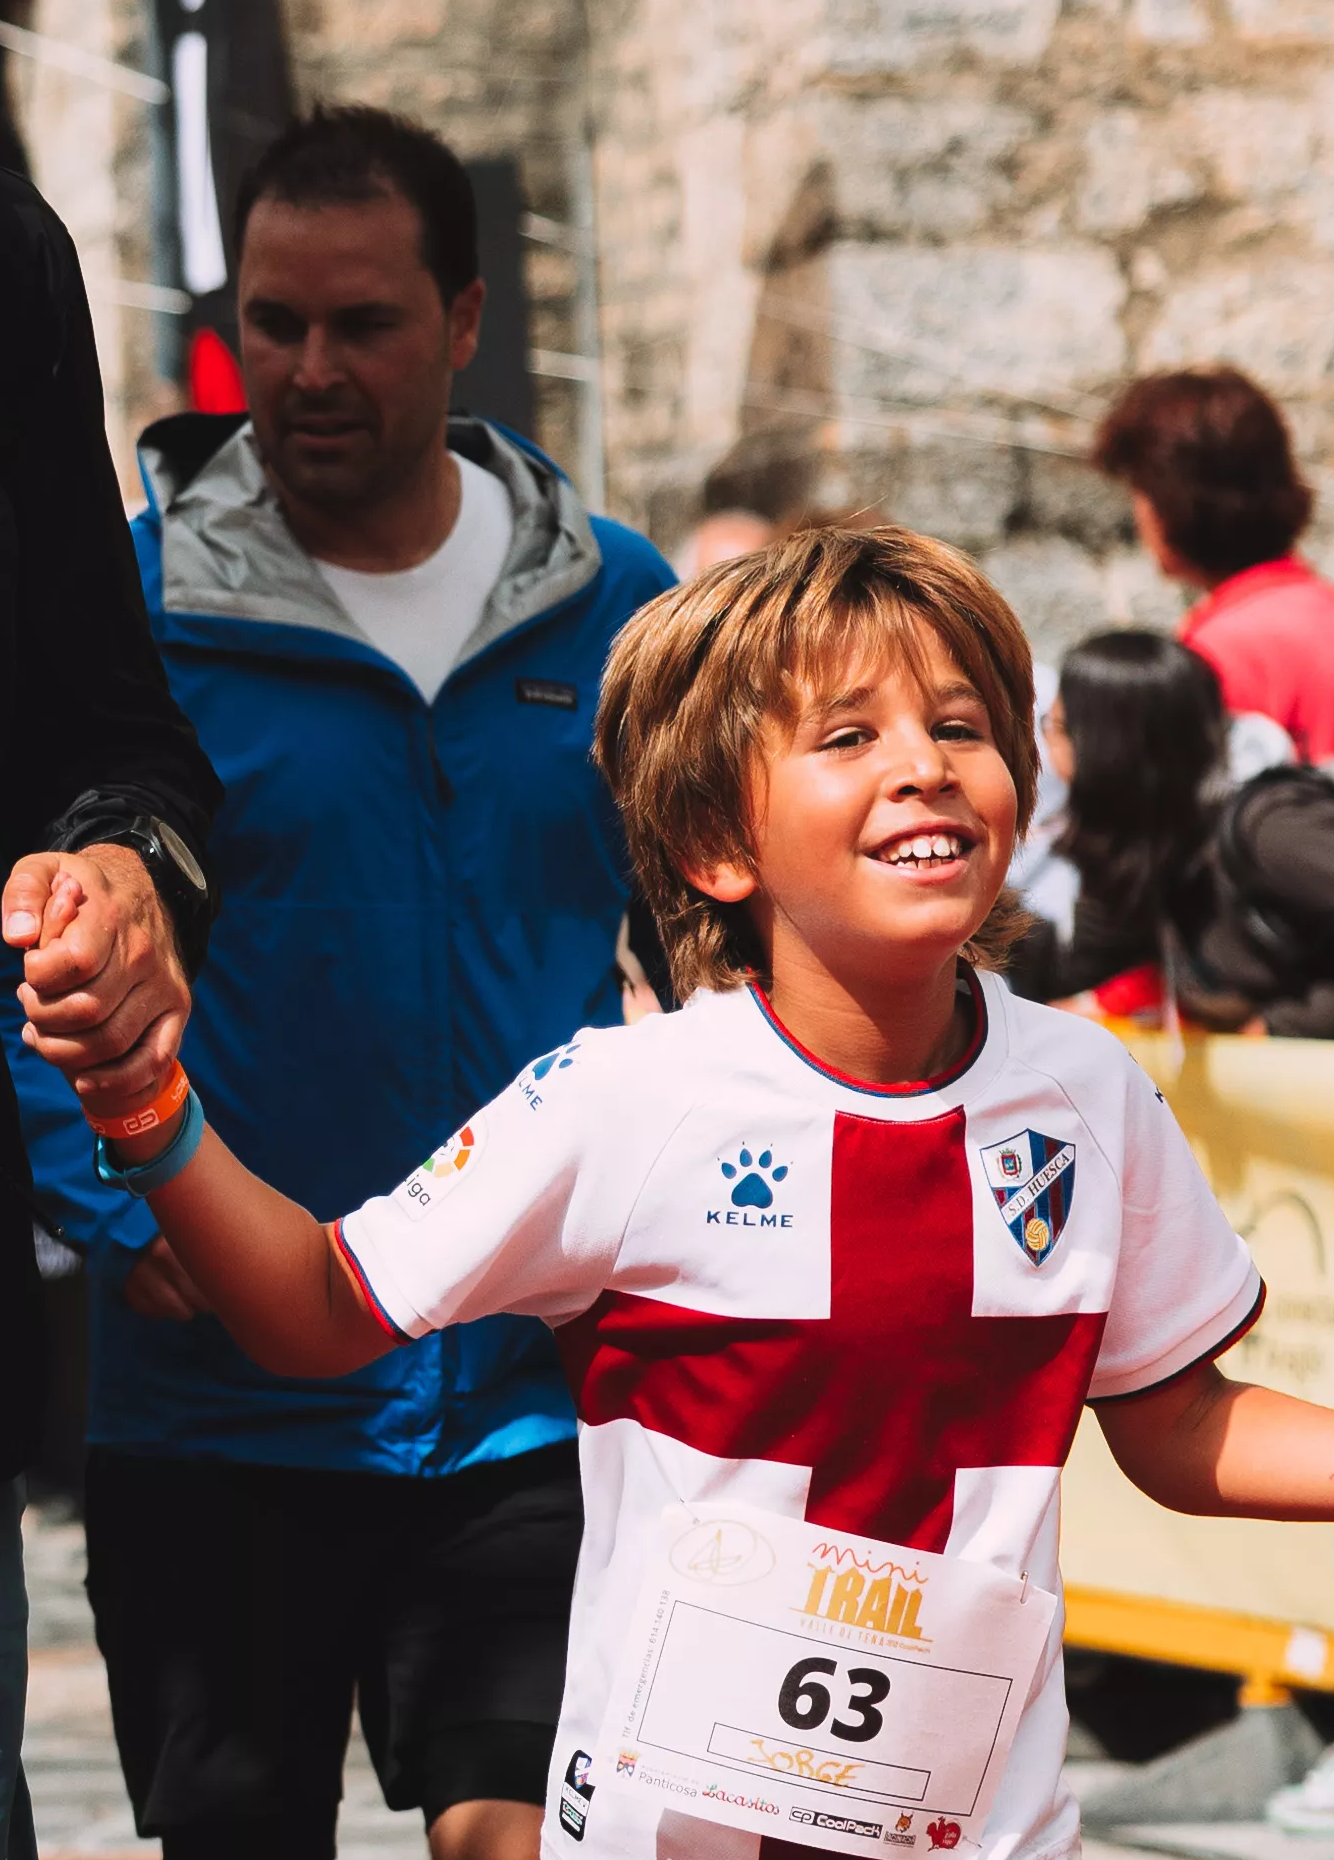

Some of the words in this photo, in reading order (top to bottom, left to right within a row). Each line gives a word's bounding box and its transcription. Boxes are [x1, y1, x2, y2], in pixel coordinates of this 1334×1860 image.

[403, 1173, 432, 1207] iga
[1027, 1152, 1071, 1198] HUESCA
[706, 1209, 794, 1228] KELME
[812, 1542, 929, 1584] mini
[806, 1562, 924, 1639] TRAIL
[857, 1631, 885, 1647] TENA
[777, 1656, 892, 1743] 63
[747, 1739, 866, 1788] JORGE
[638, 1771, 699, 1798] Panticosa
[816, 1813, 882, 1838] CoolPack
